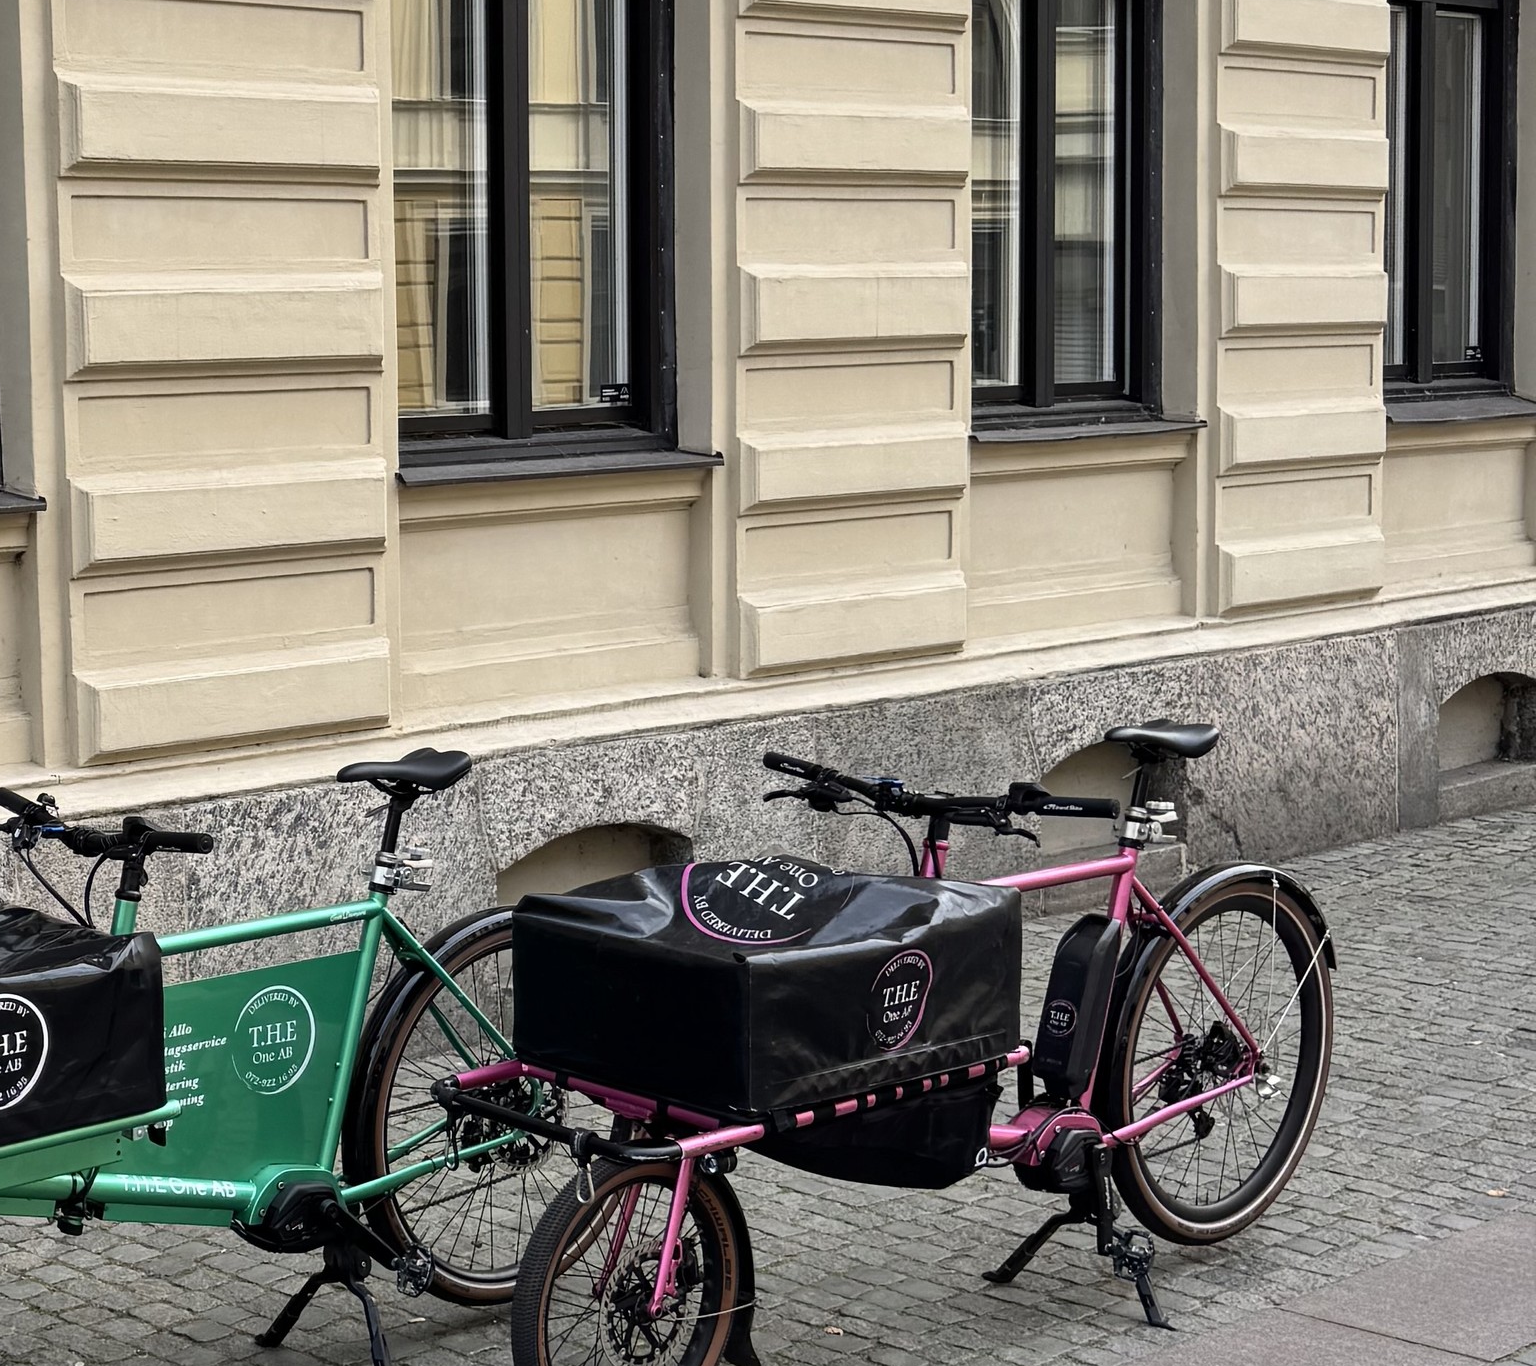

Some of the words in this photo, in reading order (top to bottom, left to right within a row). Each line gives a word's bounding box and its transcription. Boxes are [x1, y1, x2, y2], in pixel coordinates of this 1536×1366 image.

[780, 862, 818, 888] One
[716, 861, 805, 920] T.H.E
[694, 896, 708, 909] BY
[701, 911, 772, 938] DELIVERED
[248, 993, 288, 1014] DELIVERED
[288, 997, 299, 1008] BY
[883, 980, 919, 1007] T.H.E
[17, 1007, 30, 1017] BY
[169, 1023, 192, 1038] Allo
[249, 1020, 296, 1047] T.H.E
[164, 1035, 227, 1057] tagsservice
[253, 1052, 275, 1064] One
[278, 1047, 292, 1060] AB
[5, 1058, 22, 1073] AB
[165, 1060, 185, 1074] stik
[166, 1077, 199, 1092] tering
[116, 1175, 166, 1193] T.H.E
[169, 1178, 207, 1195] One
[212, 1181, 236, 1197] AB
[696, 1188, 732, 1291] CHWALBE
